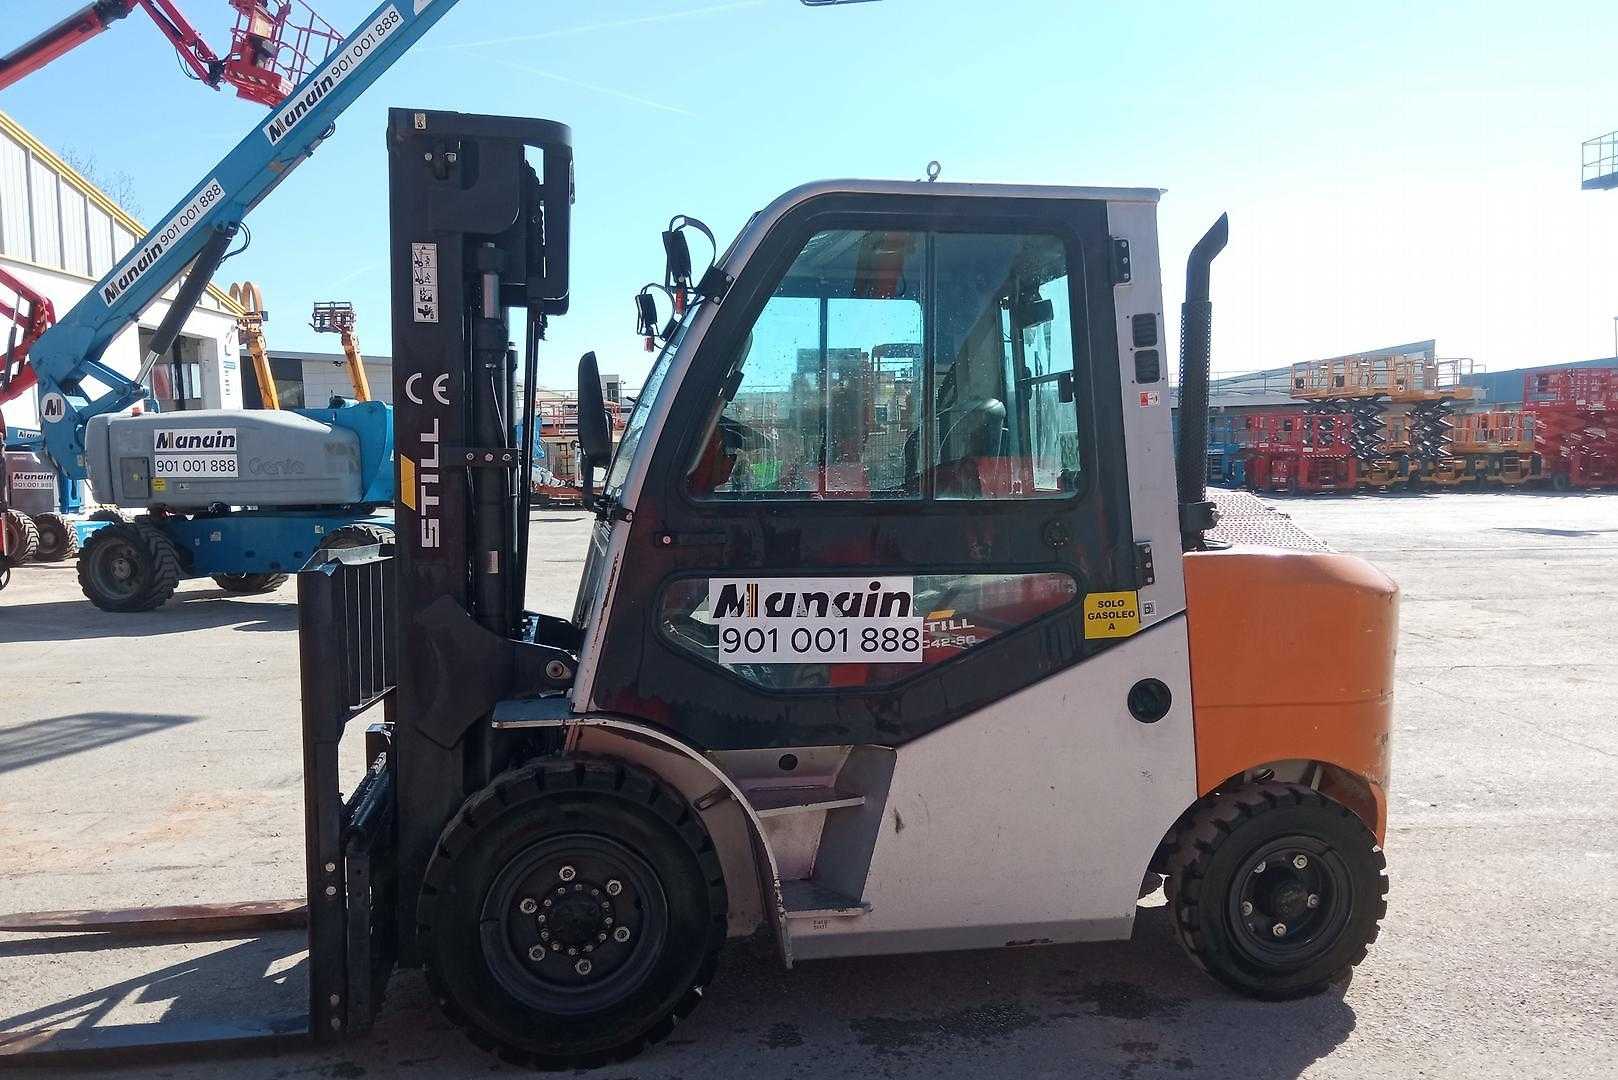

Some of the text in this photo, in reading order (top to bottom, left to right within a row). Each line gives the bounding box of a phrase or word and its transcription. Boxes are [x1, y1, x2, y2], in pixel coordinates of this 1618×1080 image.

[268, 75, 333, 143] Manain
[331, 54, 353, 79] 901
[353, 33, 376, 57] 001
[375, 10, 399, 37] 888
[104, 184, 221, 304] Manain 901 001 888
[406, 372, 449, 405] CE
[156, 430, 236, 449] Manain
[156, 459, 236, 472] 901 001 888
[420, 418, 439, 548] STILL
[712, 581, 911, 619] Manain
[1097, 600, 1125, 608] SOLO
[1087, 611, 1135, 620] GASOLEO
[722, 626, 920, 654] 901 001 888
